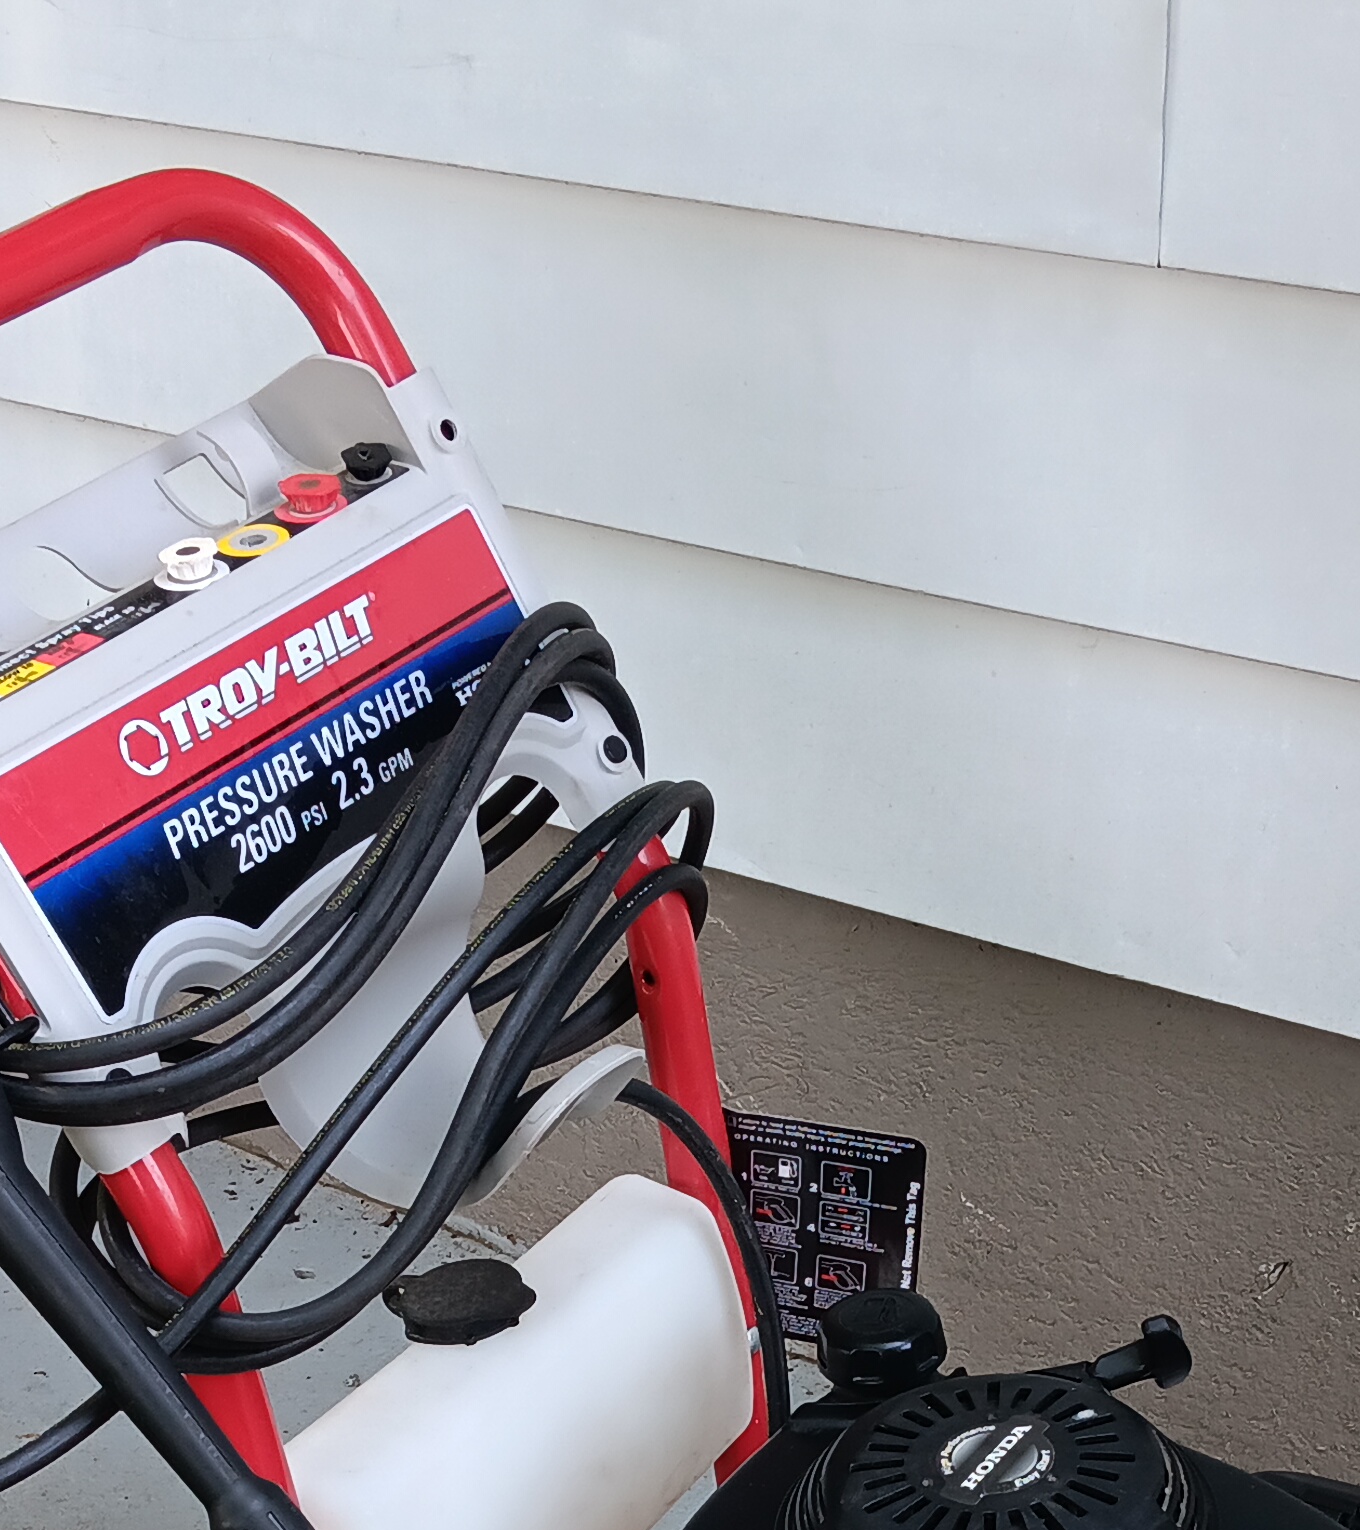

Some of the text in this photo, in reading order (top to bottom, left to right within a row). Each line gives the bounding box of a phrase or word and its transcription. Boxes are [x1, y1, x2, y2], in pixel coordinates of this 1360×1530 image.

[159, 594, 375, 752] TROY-BILT
[162, 742, 313, 859] PRESSURE
[310, 669, 433, 767] WASHER
[231, 747, 414, 873] 2600 PSI 2.3 GPM
[734, 1133, 798, 1148] OPERATING
[805, 1143, 889, 1163] INSTRUCTIONS
[809, 1182, 818, 1193] 2
[806, 1223, 816, 1233] 4
[900, 1181, 921, 1289] Not Remove This Tag
[960, 1425, 1033, 1490] HONDA
